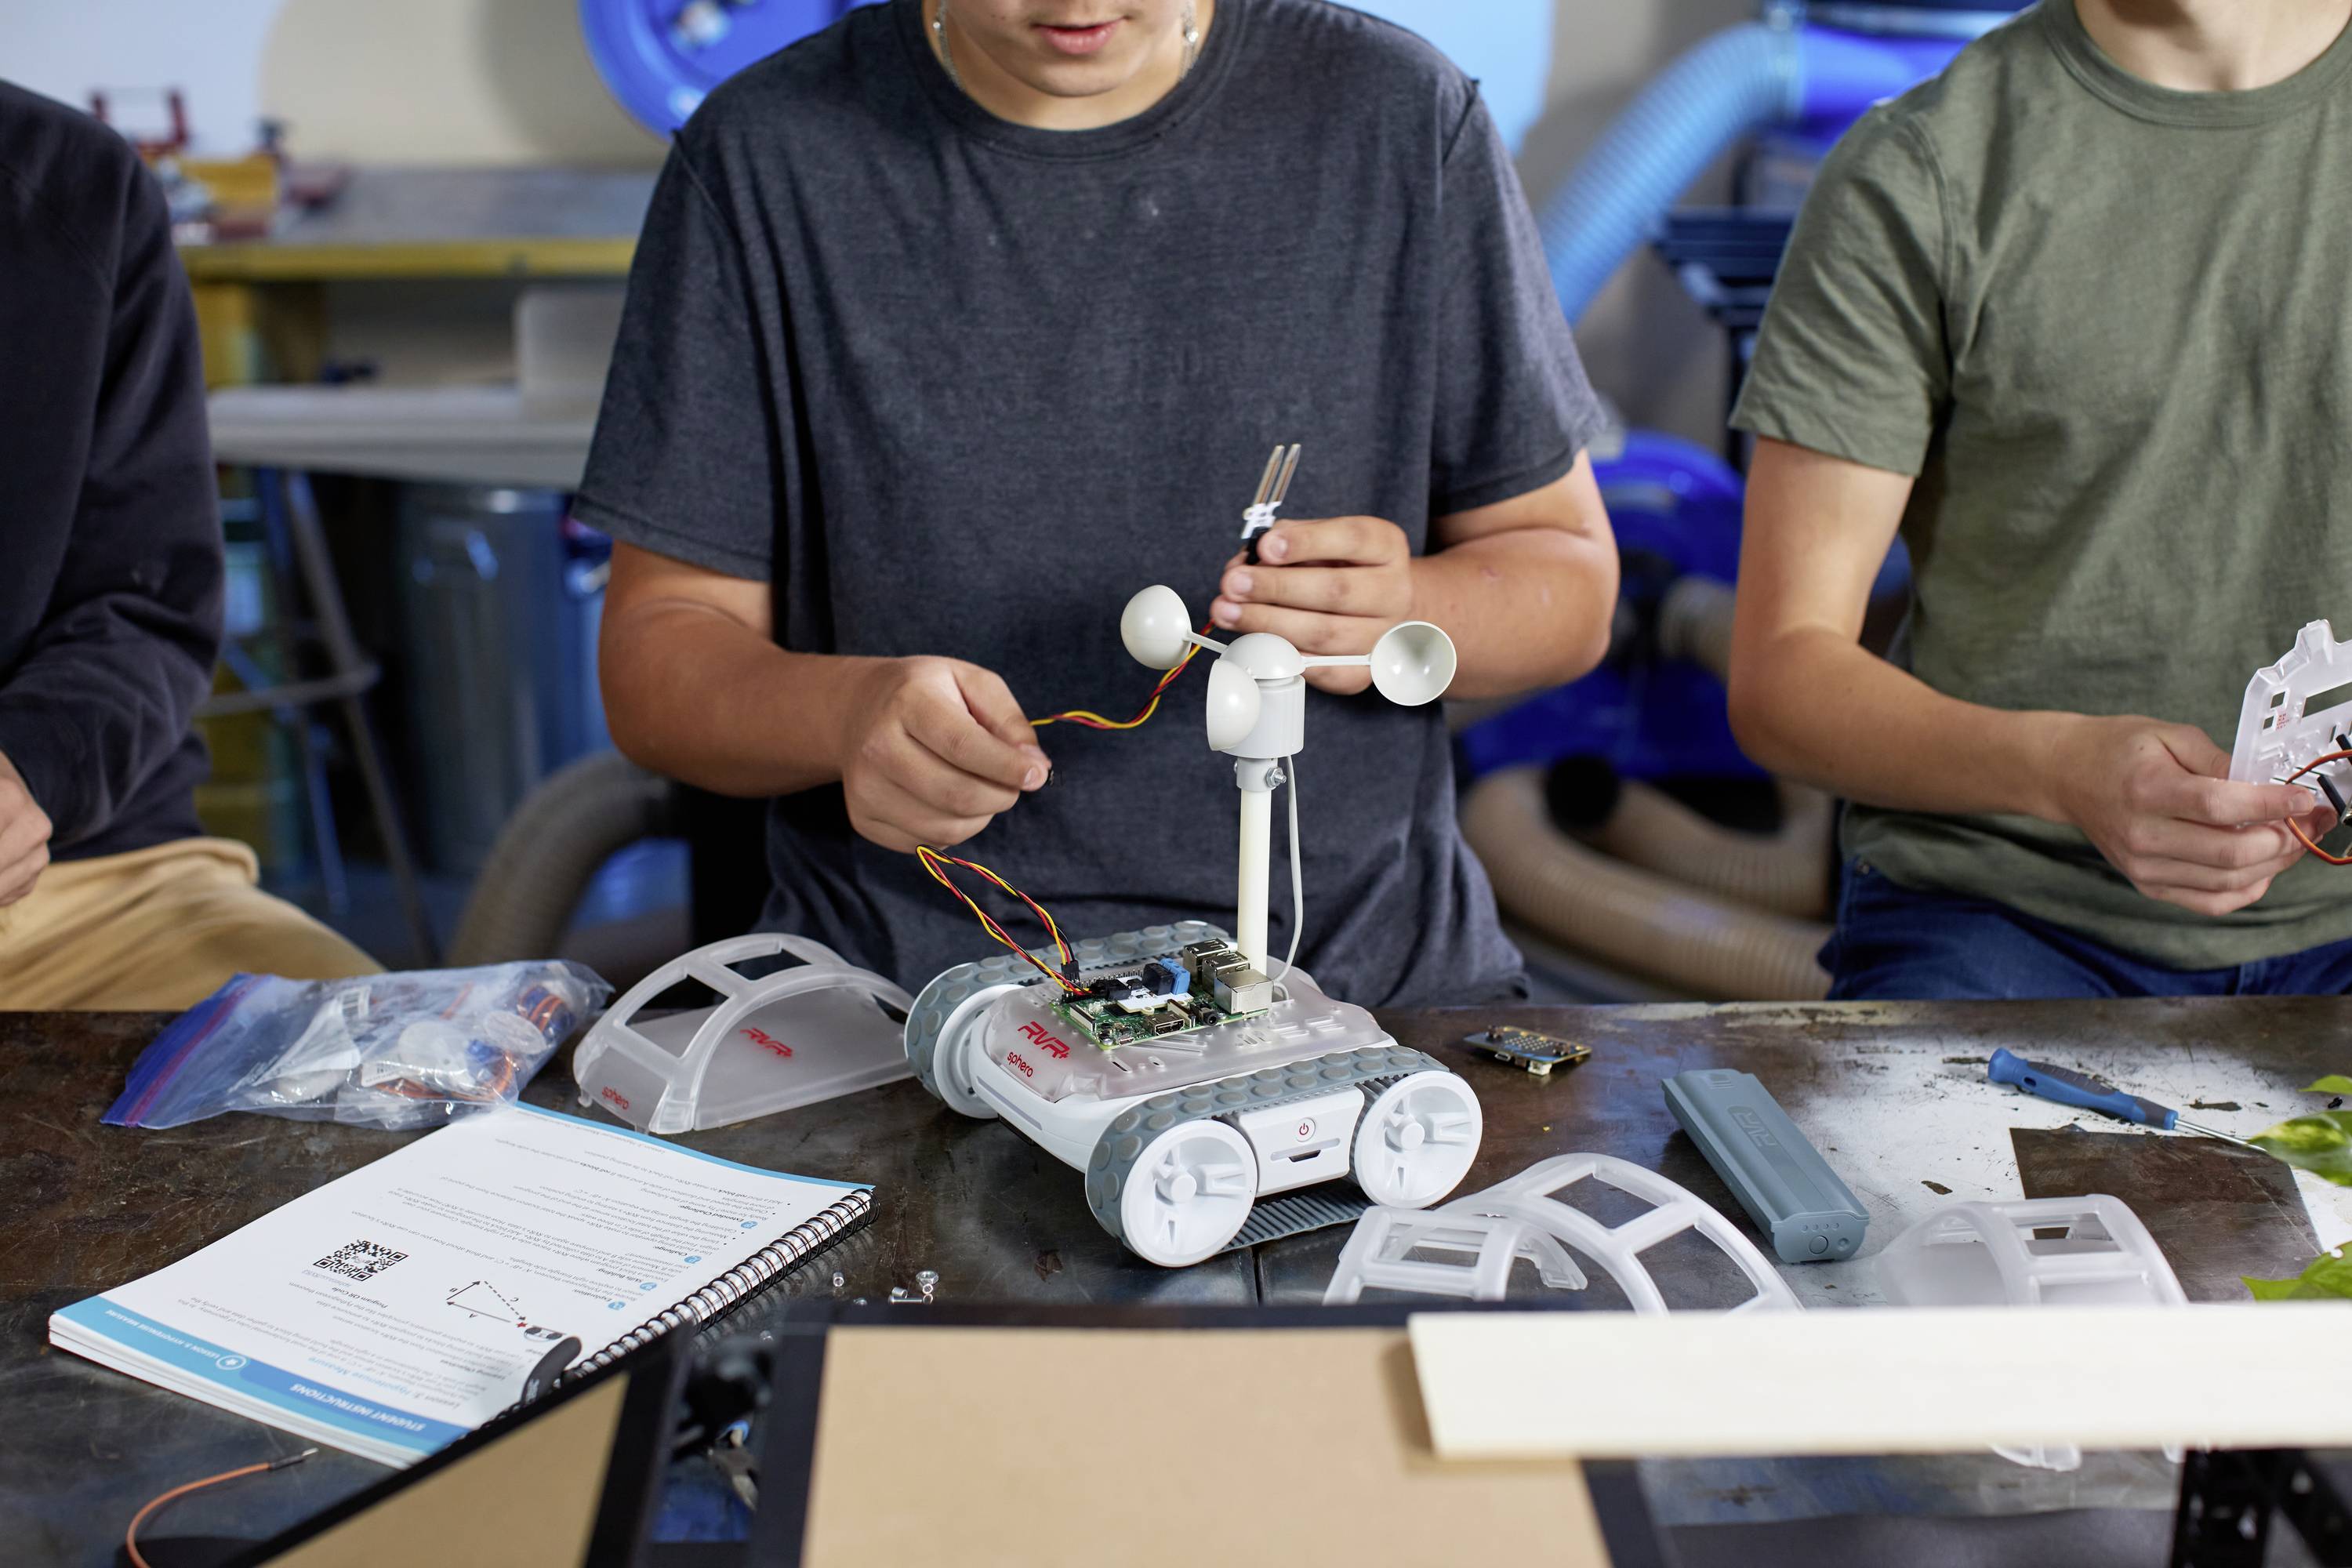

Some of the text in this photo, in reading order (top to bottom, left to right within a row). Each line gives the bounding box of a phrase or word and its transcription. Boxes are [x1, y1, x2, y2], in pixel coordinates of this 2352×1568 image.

[1007, 1051, 1033, 1078] sphero
[601, 1086, 630, 1110] sphero
[710, 1212, 744, 1223] Extended
[329, 1286, 350, 1295] Code
[358, 1295, 390, 1308] Program
[103, 1308, 141, 1326] MEASURE
[136, 1323, 186, 1345] HYPOTENUSE
[190, 1345, 221, 1359] LESSON
[289, 1382, 426, 1432] STUDENT INSTRUCTIONS
